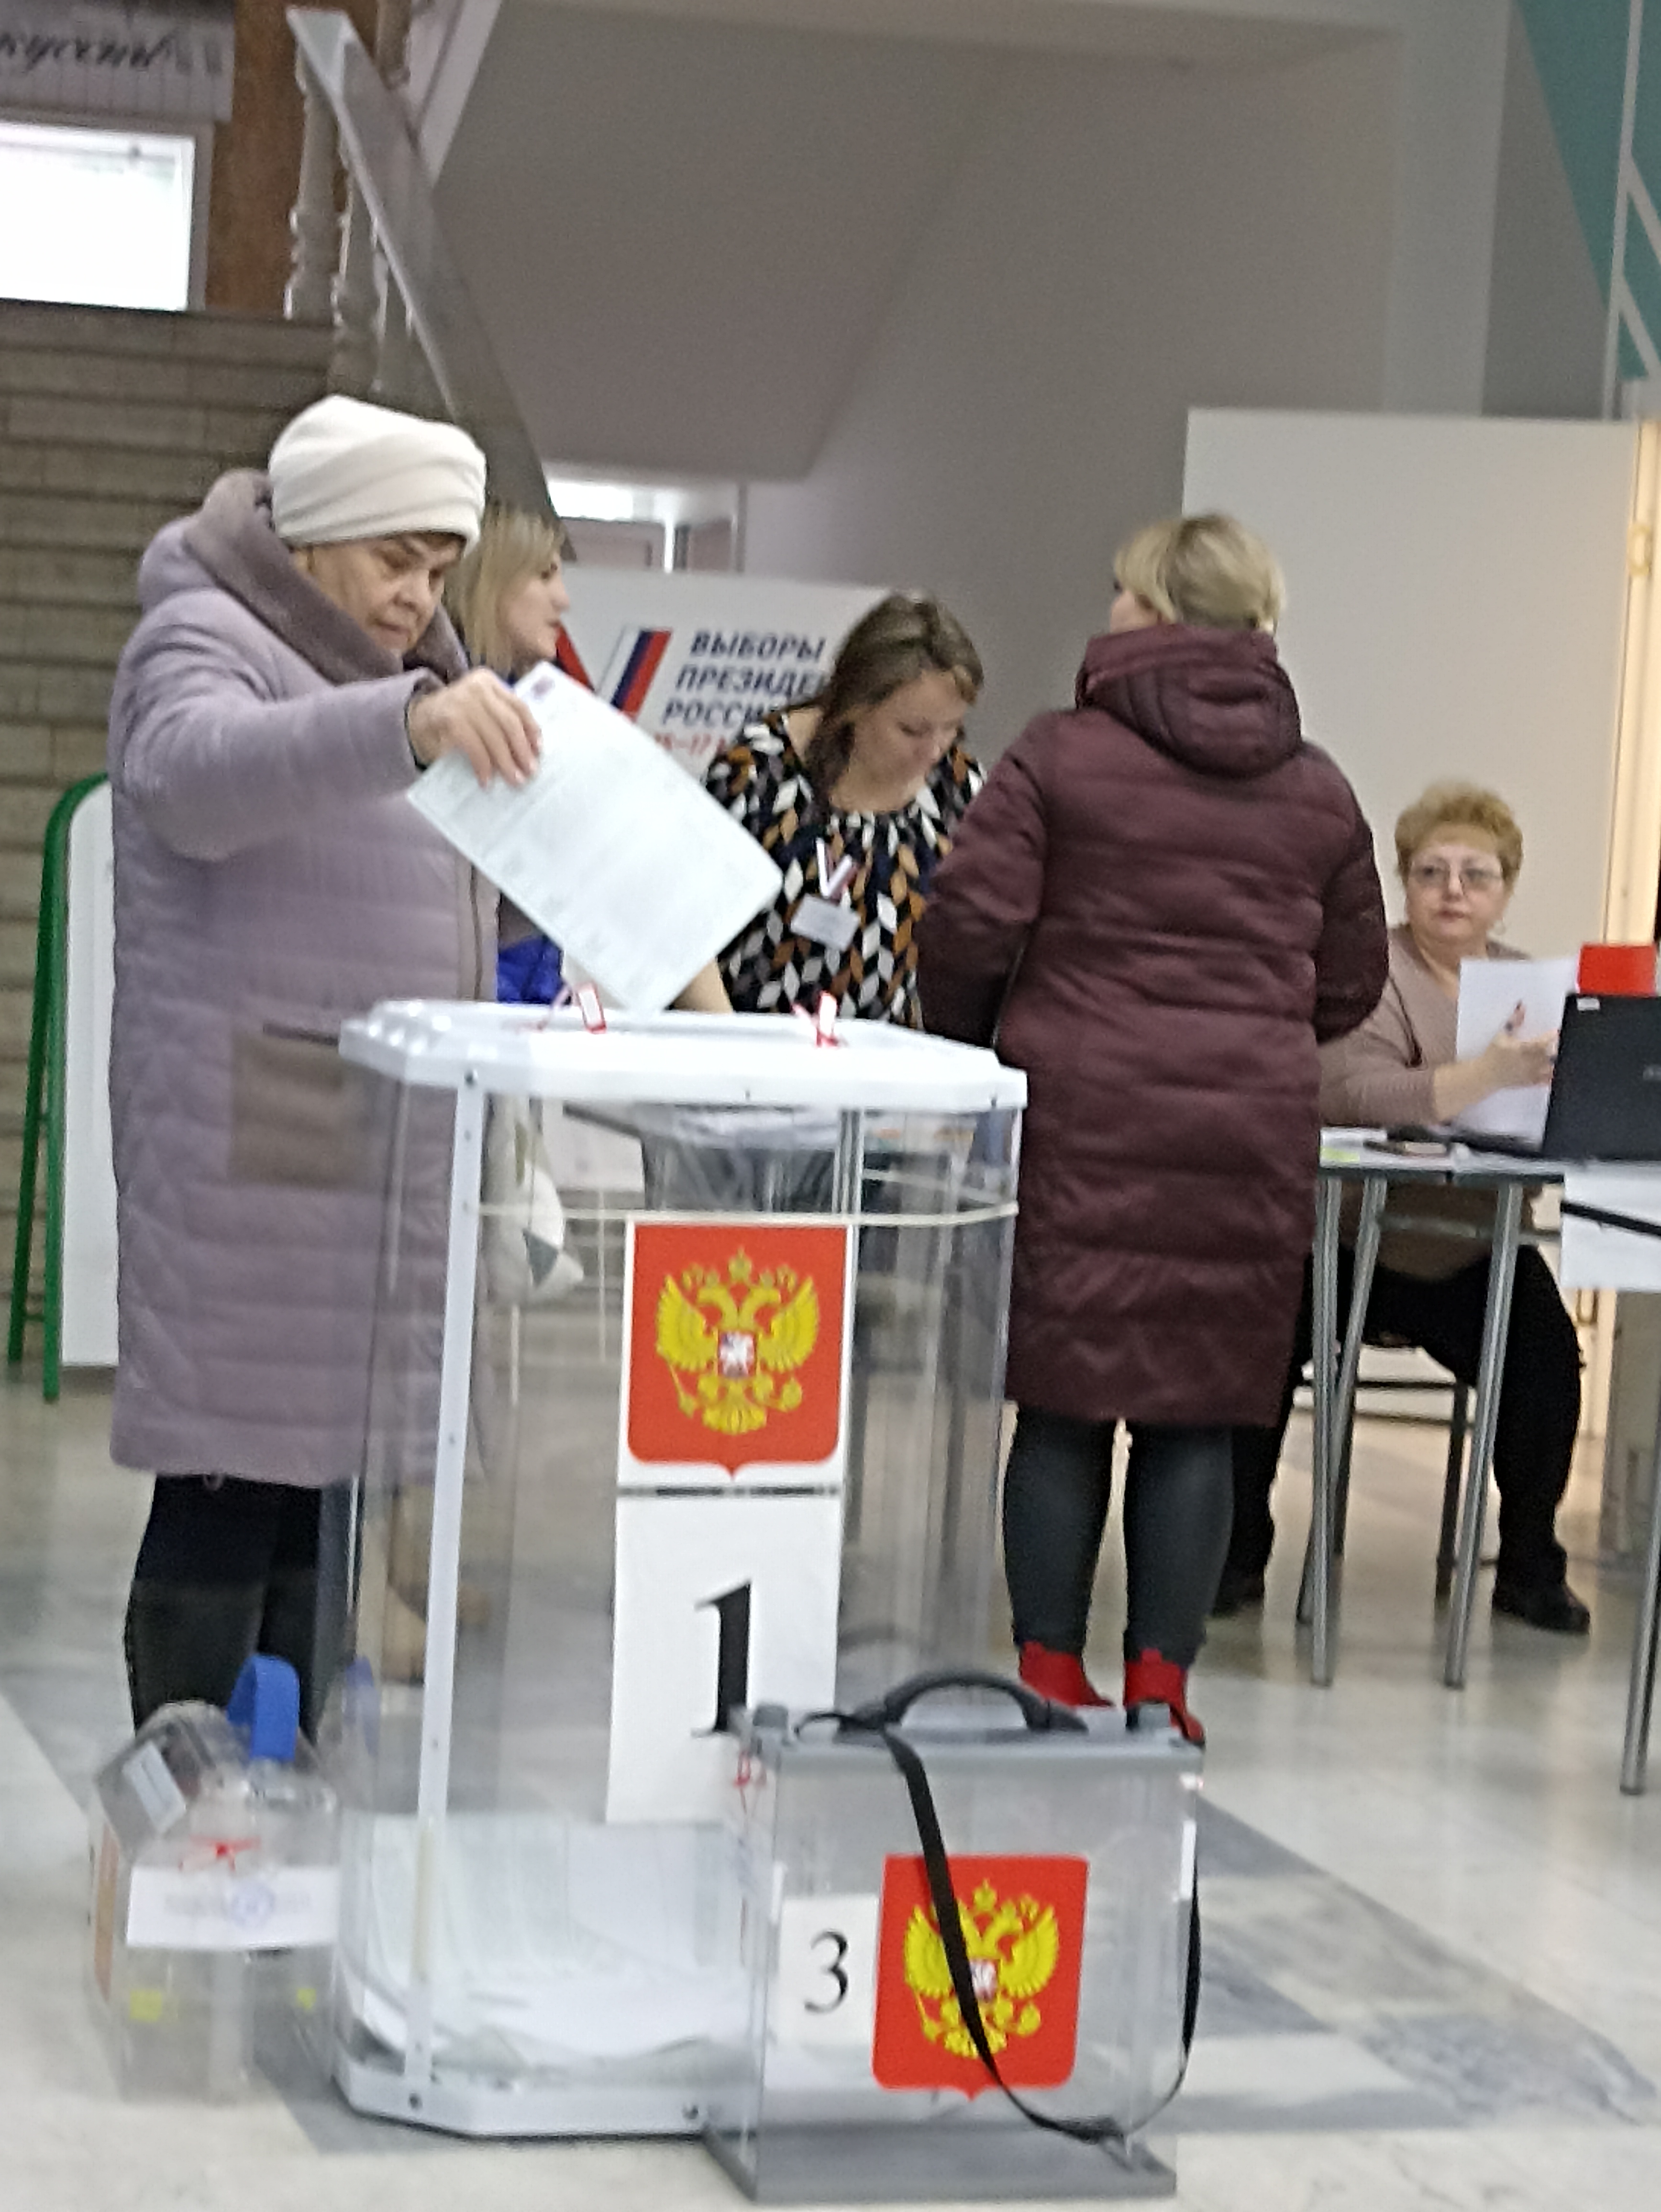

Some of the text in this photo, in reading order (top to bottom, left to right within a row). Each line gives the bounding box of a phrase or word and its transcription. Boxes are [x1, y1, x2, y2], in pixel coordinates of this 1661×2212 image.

[690, 630, 826, 662] ВЫБОРЫ
[675, 664, 824, 699] ПРЕЗИДЕ
[660, 698, 766, 729] РОССИ
[690, 1578, 753, 1738] 1
[803, 1928, 849, 2014] 3
